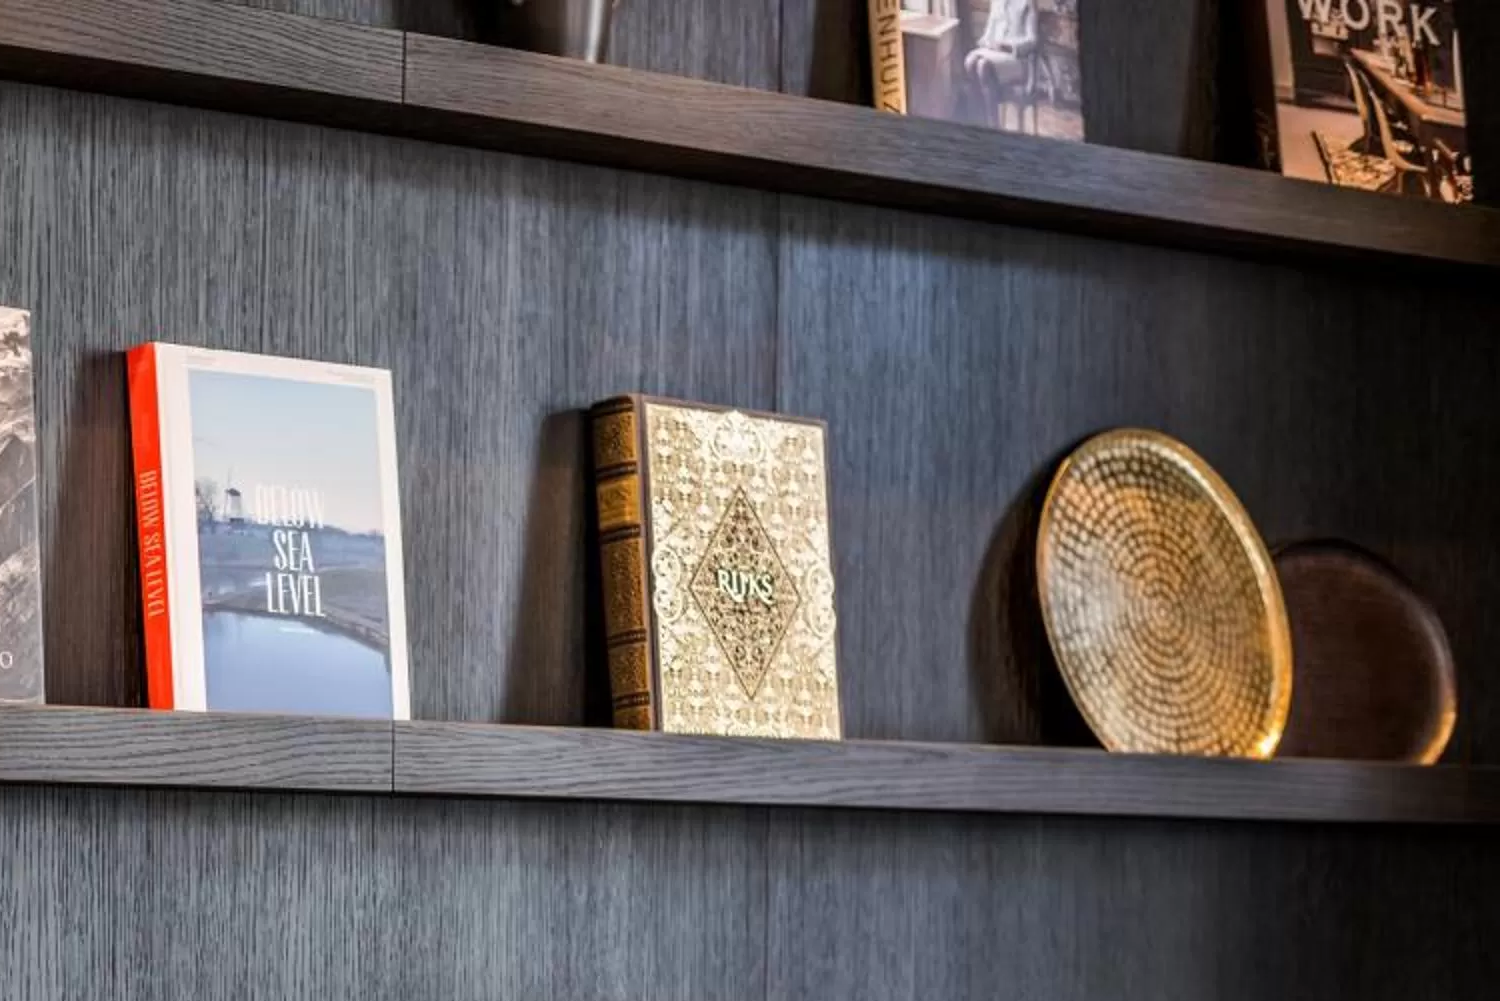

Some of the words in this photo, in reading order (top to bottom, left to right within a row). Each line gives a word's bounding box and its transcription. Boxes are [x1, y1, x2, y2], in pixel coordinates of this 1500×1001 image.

[1299, 0, 1441, 46] WORK
[273, 529, 315, 573] SEA
[266, 572, 326, 617] LEVEL
